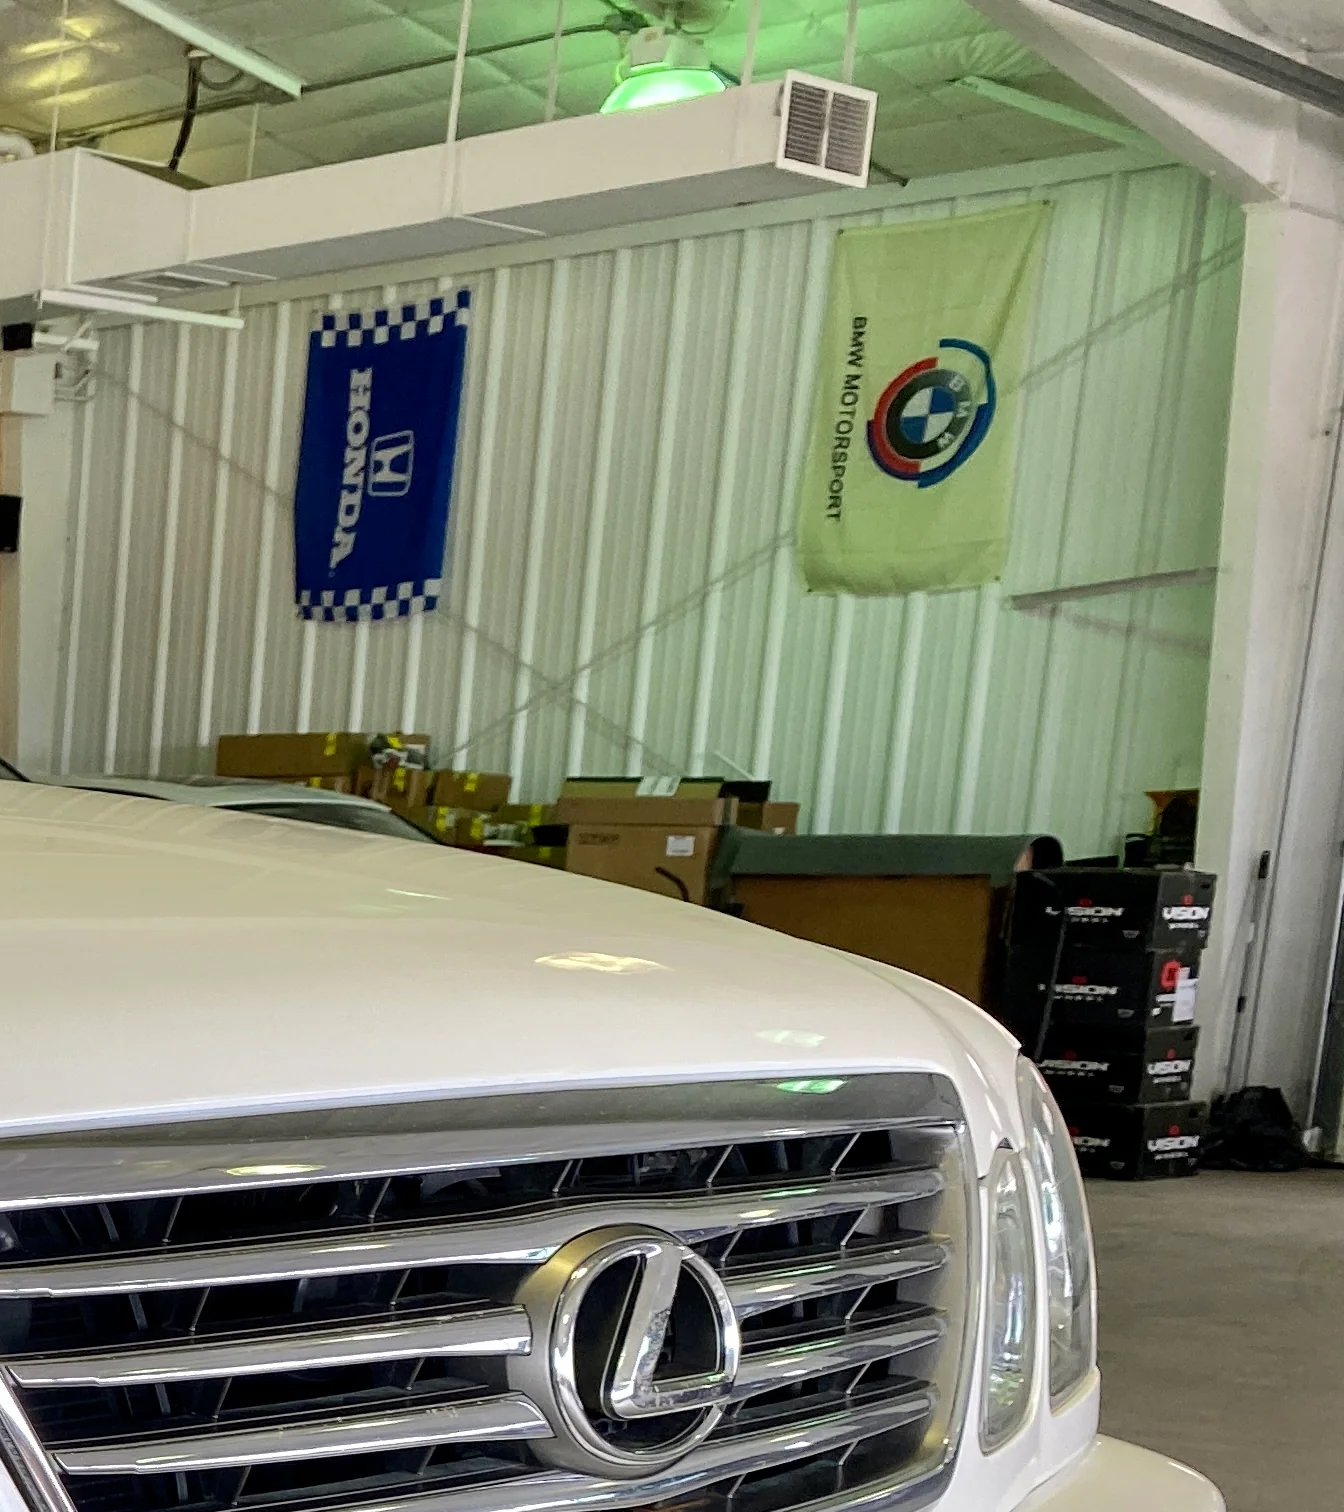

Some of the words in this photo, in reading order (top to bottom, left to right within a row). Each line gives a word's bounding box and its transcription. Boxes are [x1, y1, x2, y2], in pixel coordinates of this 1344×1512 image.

[847, 316, 868, 368] BMW
[329, 366, 373, 569] HONDA
[826, 374, 864, 522] MOTORSPORT
[936, 374, 973, 450] BMW
